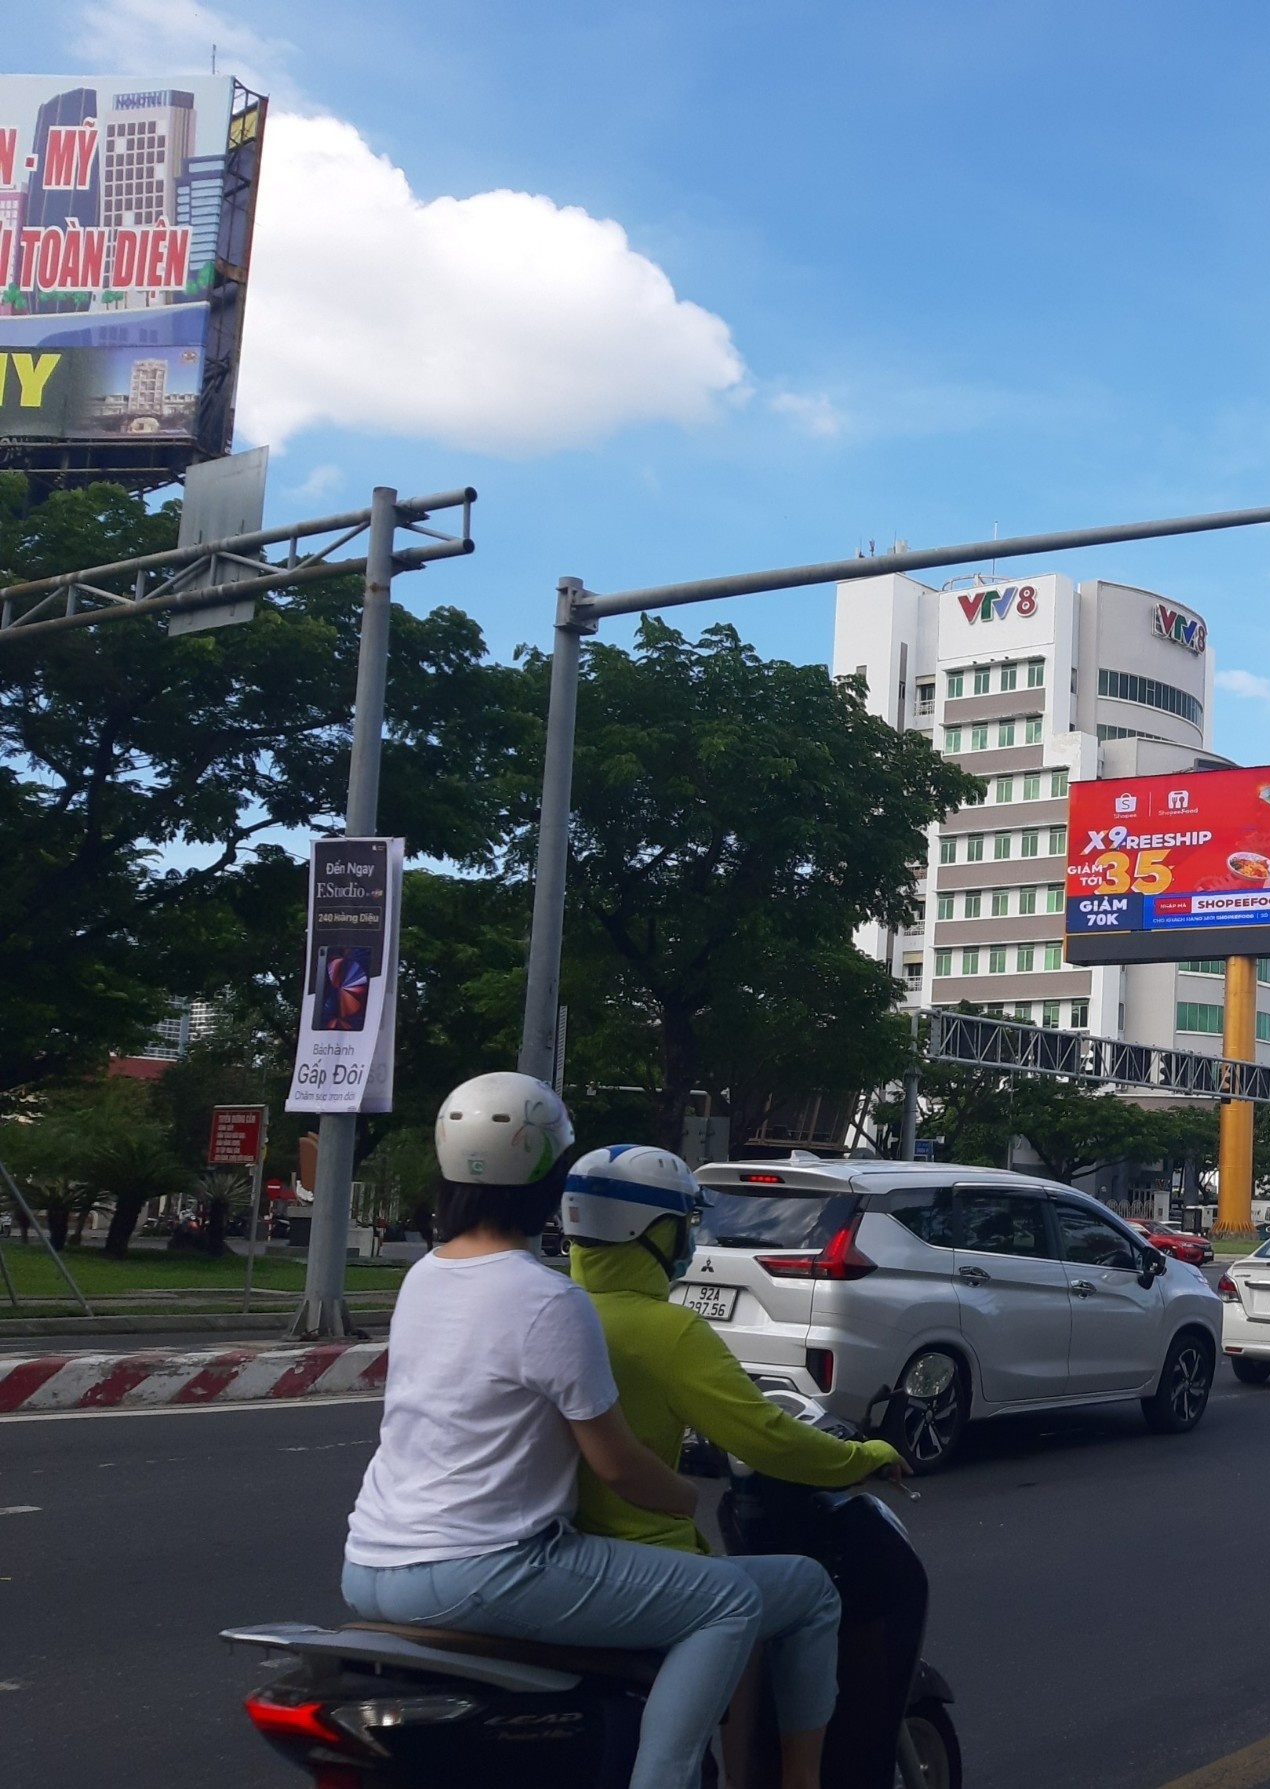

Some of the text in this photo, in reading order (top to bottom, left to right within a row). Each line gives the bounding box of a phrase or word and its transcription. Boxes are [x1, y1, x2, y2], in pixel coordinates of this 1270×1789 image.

[43, 119, 98, 188] MỸ
[20, 219, 105, 290] TOÀN
[112, 218, 190, 299] DIỆN
[326, 860, 375, 877] Đến Ngay
[1067, 862, 1103, 875] GIẢM
[1080, 896, 1128, 912] GIẢM
[1087, 913, 1119, 926] 70K
[298, 1059, 365, 1089] Gấp Đôi
[699, 1287, 720, 1301] 92A
